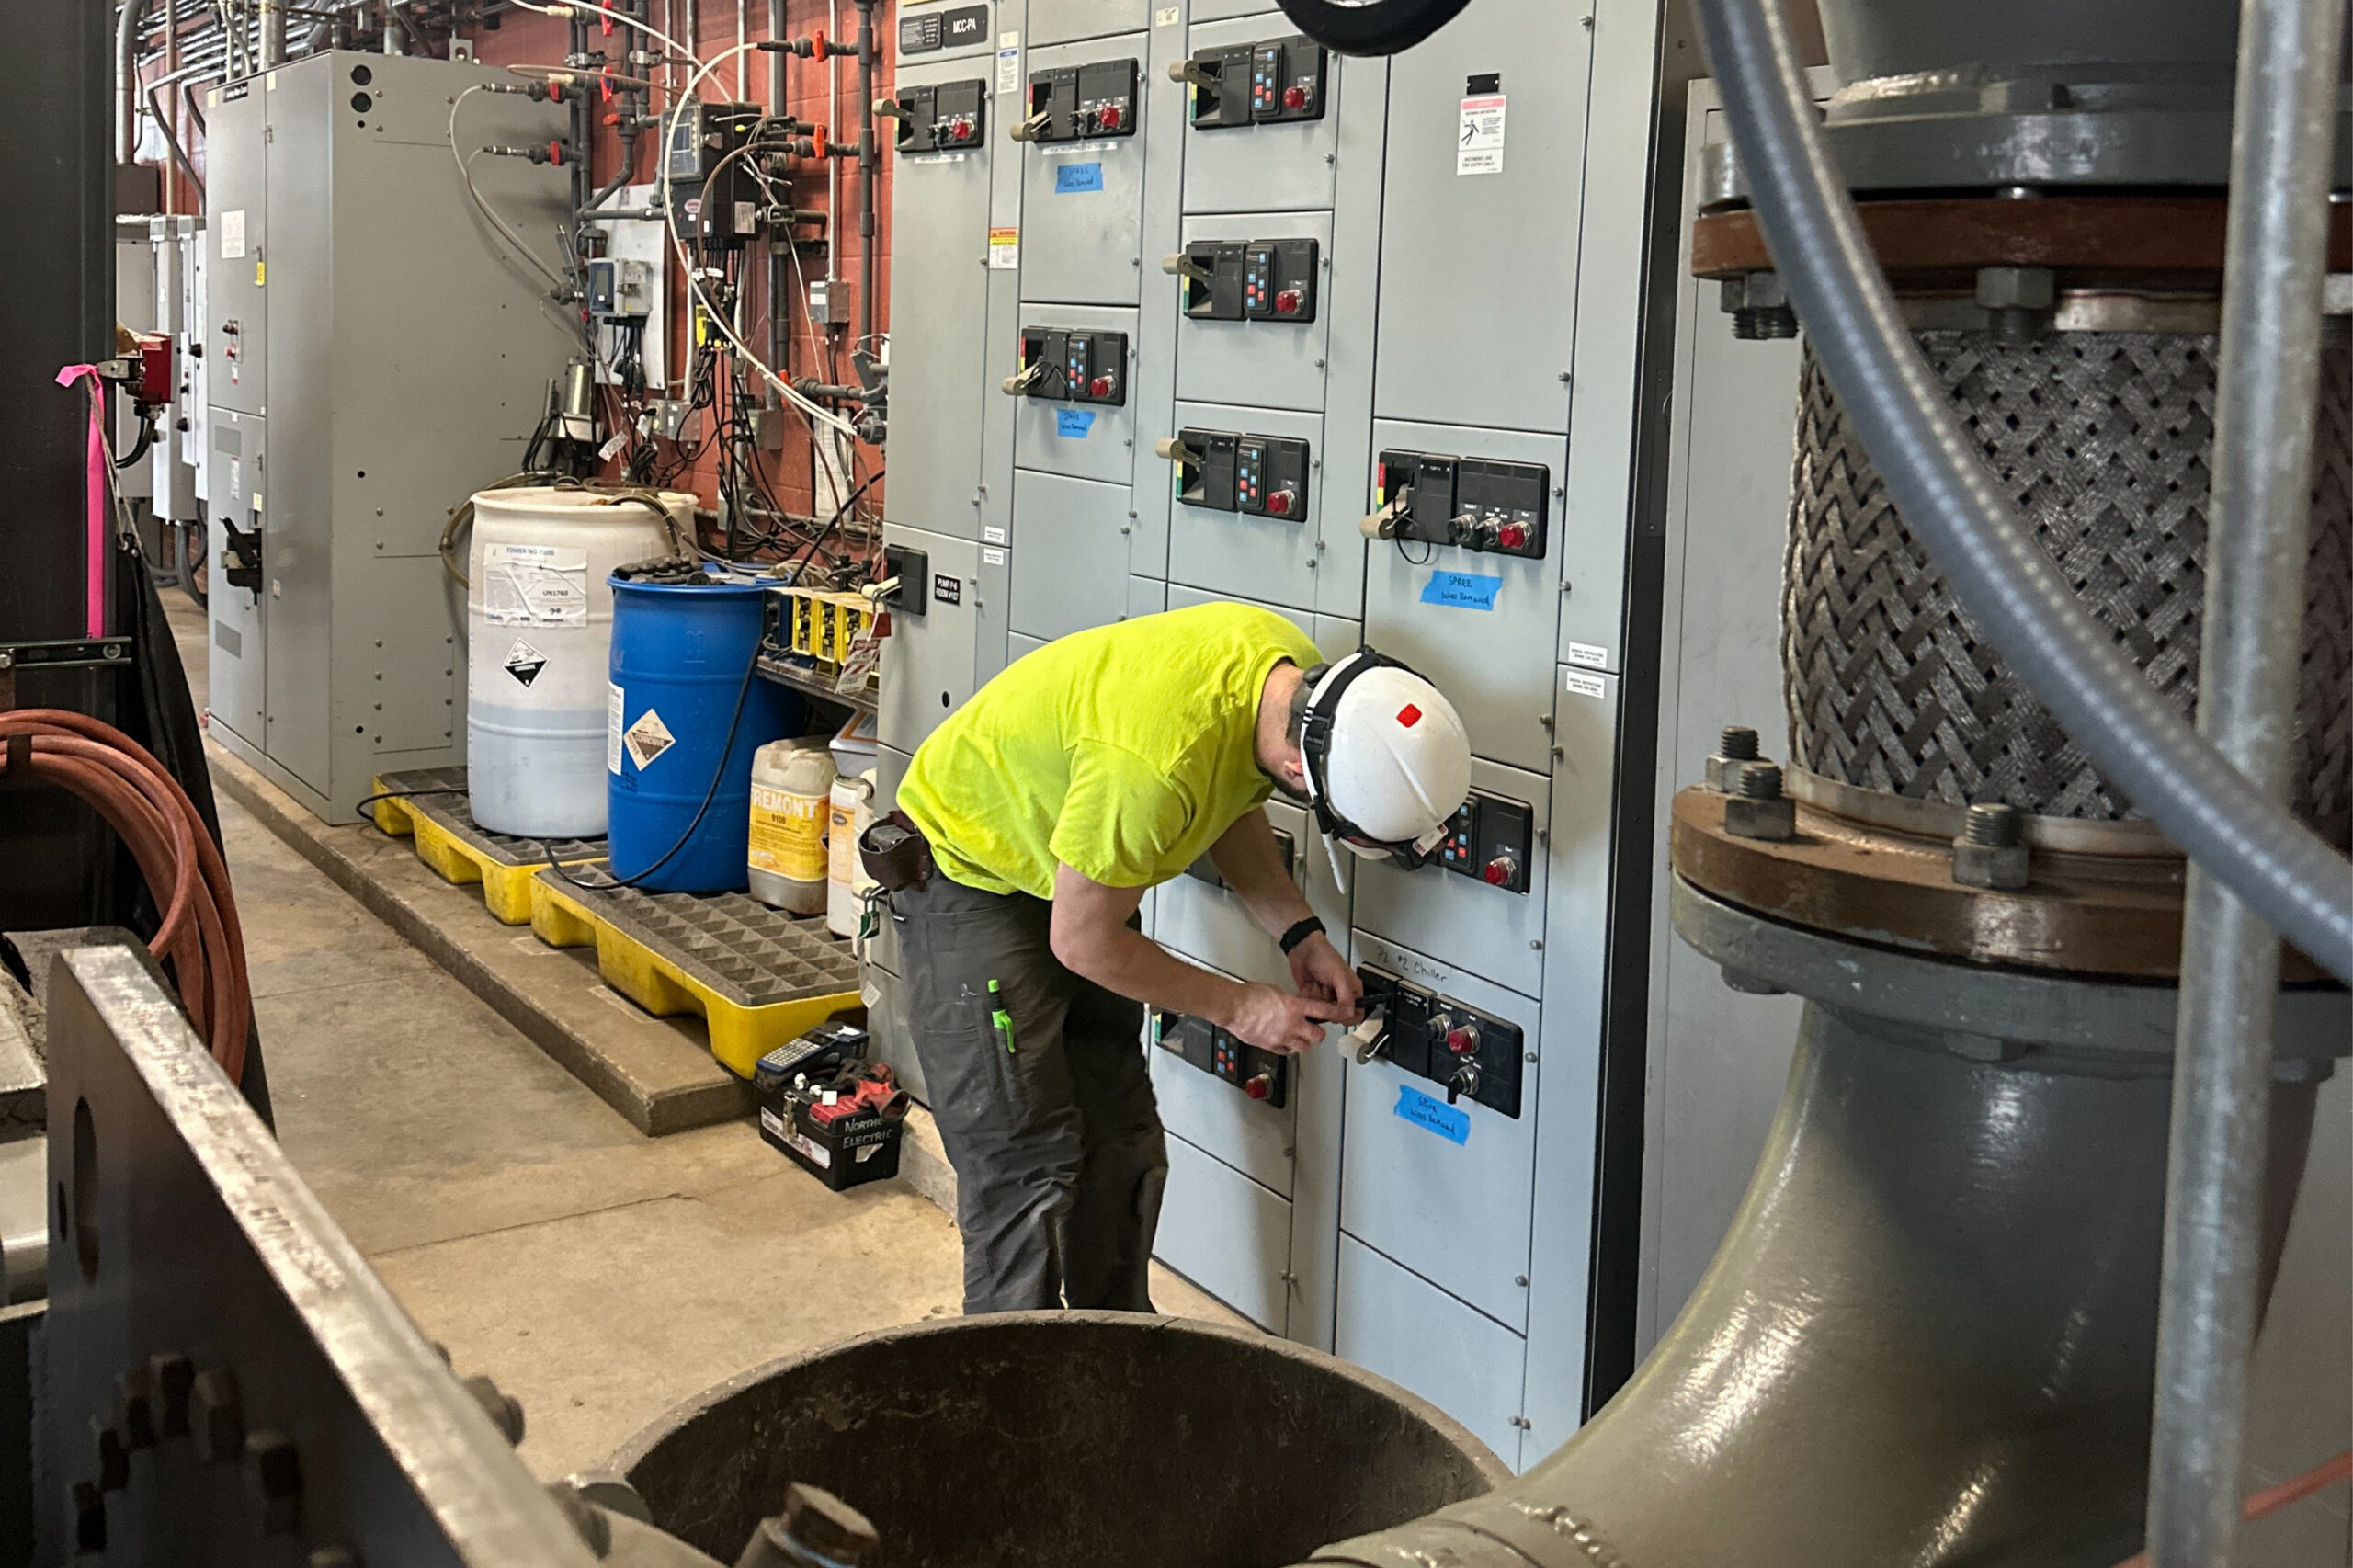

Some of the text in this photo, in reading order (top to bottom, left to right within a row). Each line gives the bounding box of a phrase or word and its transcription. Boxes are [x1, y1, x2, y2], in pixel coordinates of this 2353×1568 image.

[952, 17, 977, 34] MCC-PA
[751, 788, 817, 819] REMONT
[1414, 961, 1448, 982] Chiller
[845, 1118, 882, 1133] NORTHE
[843, 1129, 893, 1149] ELECTRIC
